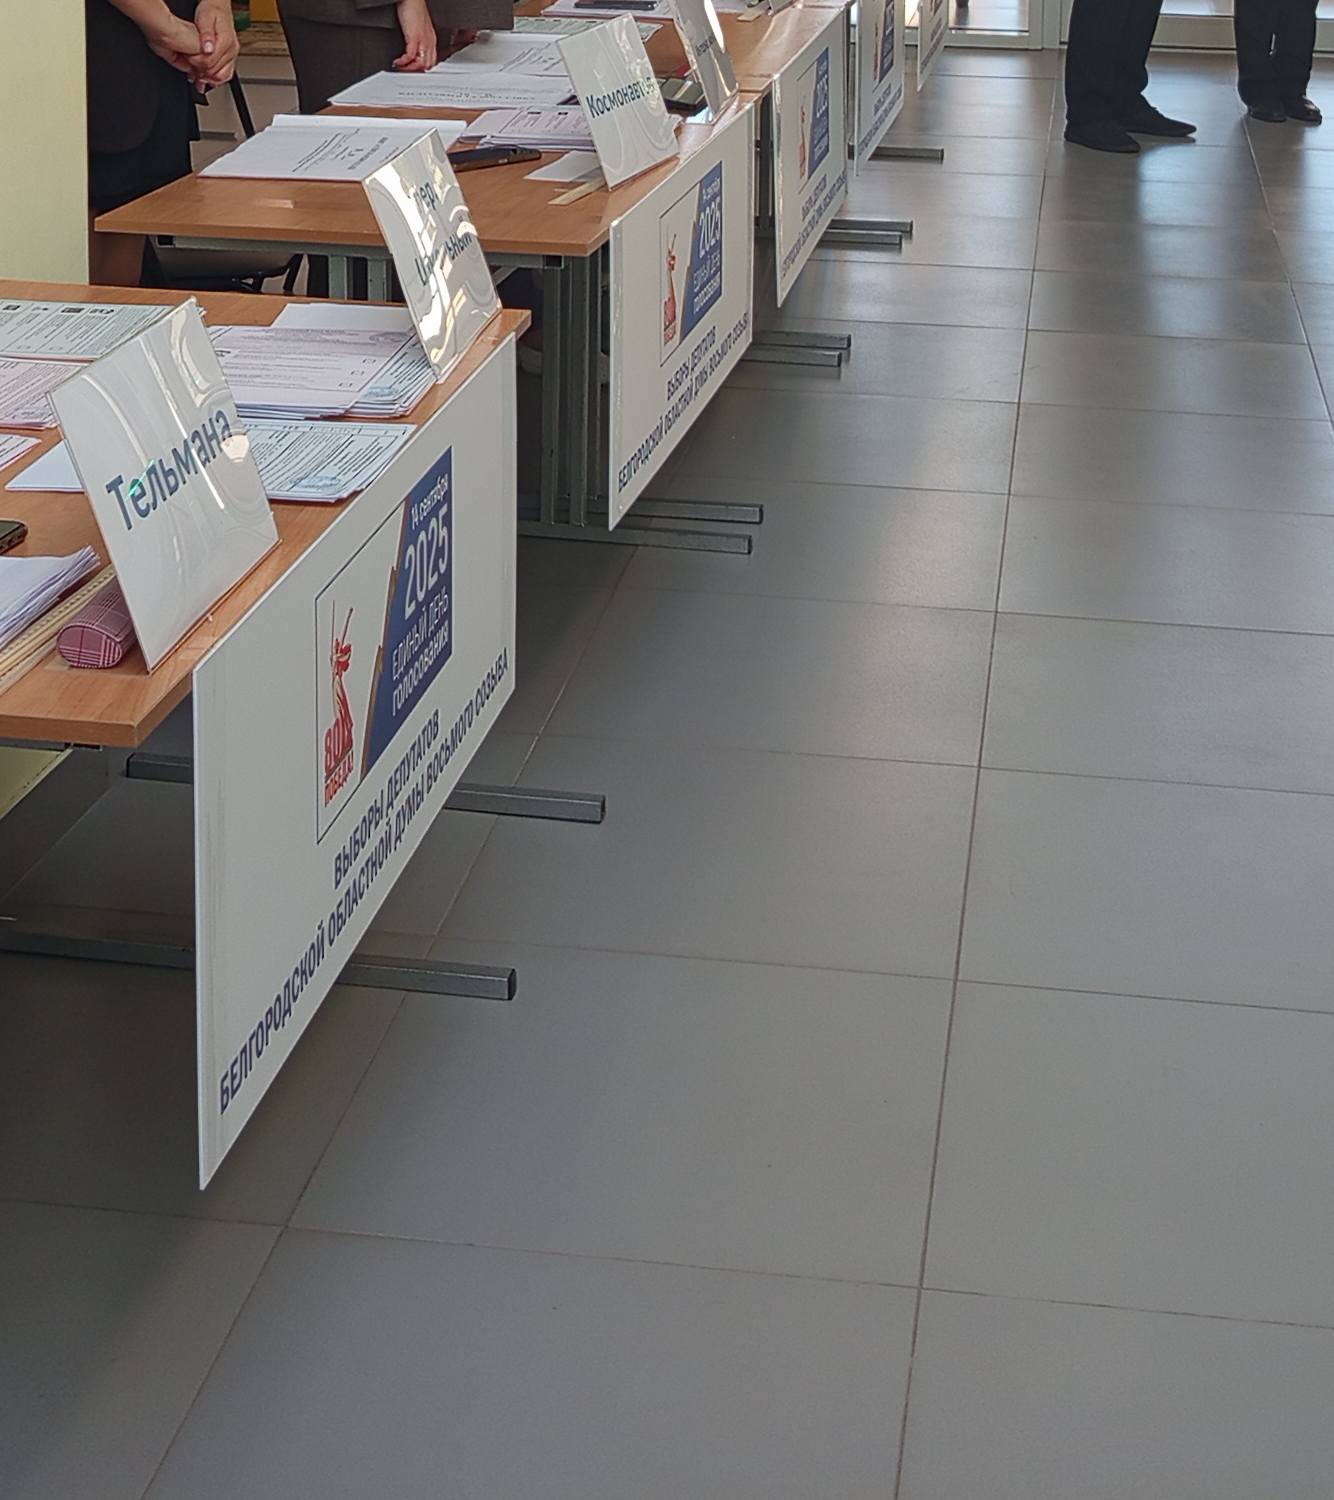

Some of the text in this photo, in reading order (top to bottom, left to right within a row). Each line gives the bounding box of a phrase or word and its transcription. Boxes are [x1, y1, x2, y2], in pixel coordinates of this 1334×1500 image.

[698, 196, 721, 259] 2025
[105, 409, 234, 531] Тельмана
[410, 472, 449, 531] 14 сентября
[618, 416, 664, 494] БЕЛГОРОДСКОЙ
[404, 503, 449, 621] 2025
[392, 585, 449, 681] ЕДИНЫЙ ДЕНЬ
[324, 750, 355, 808] ПОБЕДА!
[333, 708, 440, 890] ВЫБОРЫ ДЕПУТАТОВ
[220, 647, 509, 1115] БЕЛГОРОДСКОЙ ОБЛАСТНОЙ ДУМЫ ВОСЬМОГО СОЗЫВА
